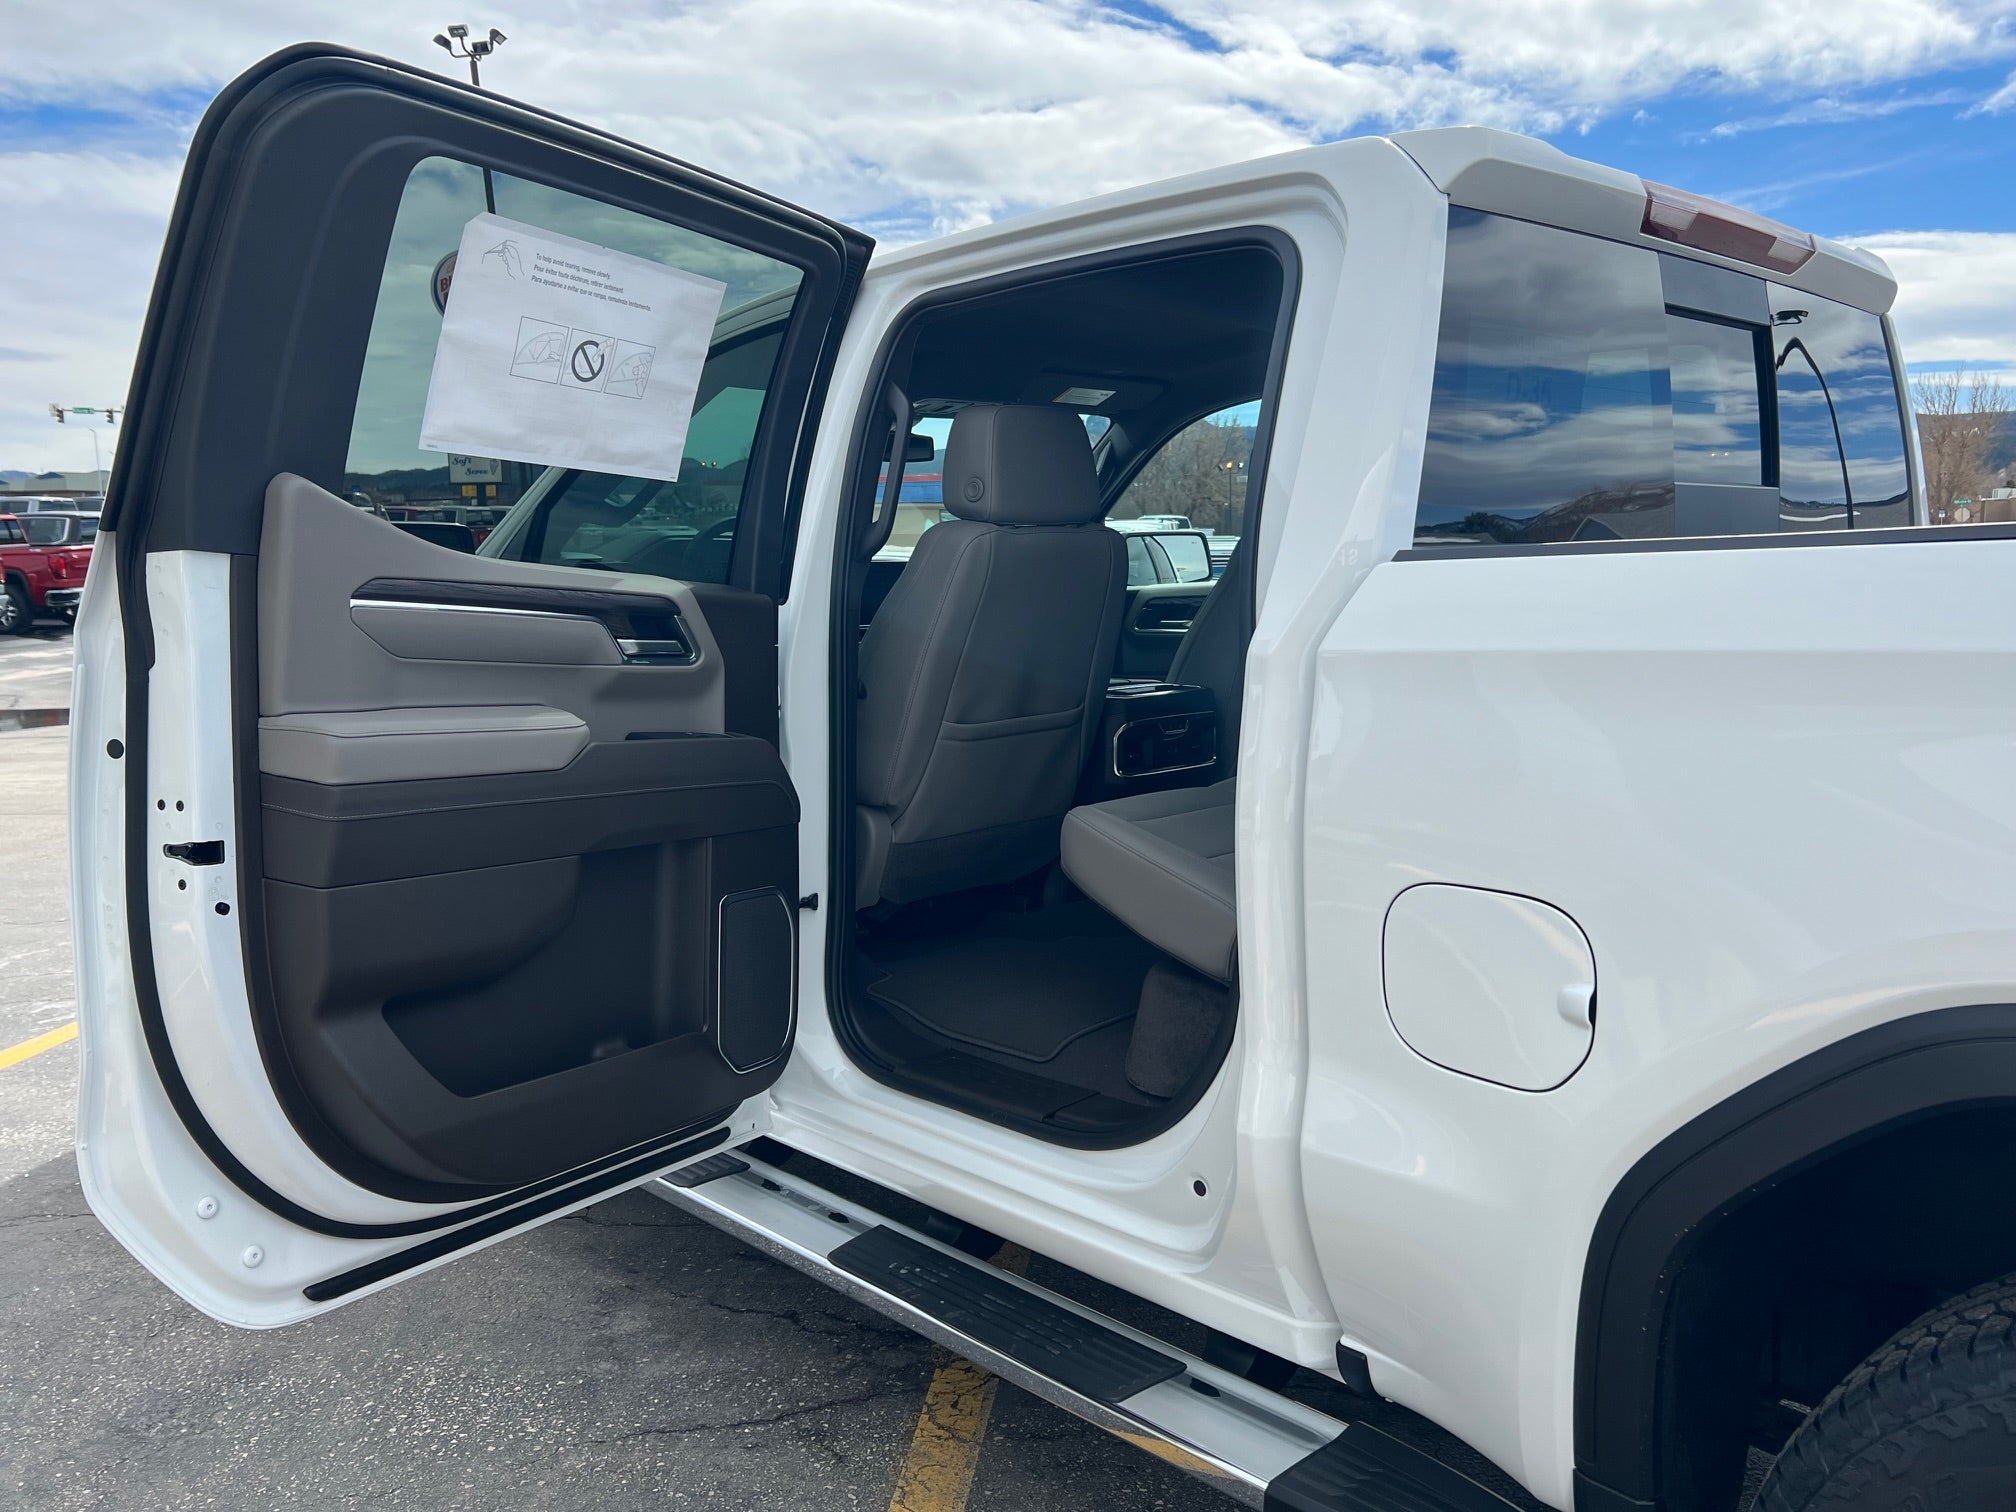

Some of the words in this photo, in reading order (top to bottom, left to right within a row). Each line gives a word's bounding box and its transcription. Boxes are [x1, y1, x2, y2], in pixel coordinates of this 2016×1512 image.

[533, 263, 545, 272] Pour
[542, 255, 552, 264] help
[552, 258, 564, 266] avoid
[581, 267, 596, 275] remove
[531, 275, 543, 283] Para
[567, 284, 579, 292] evitar
[451, 457, 472, 466] Soft
[465, 468, 488, 476] Serve
